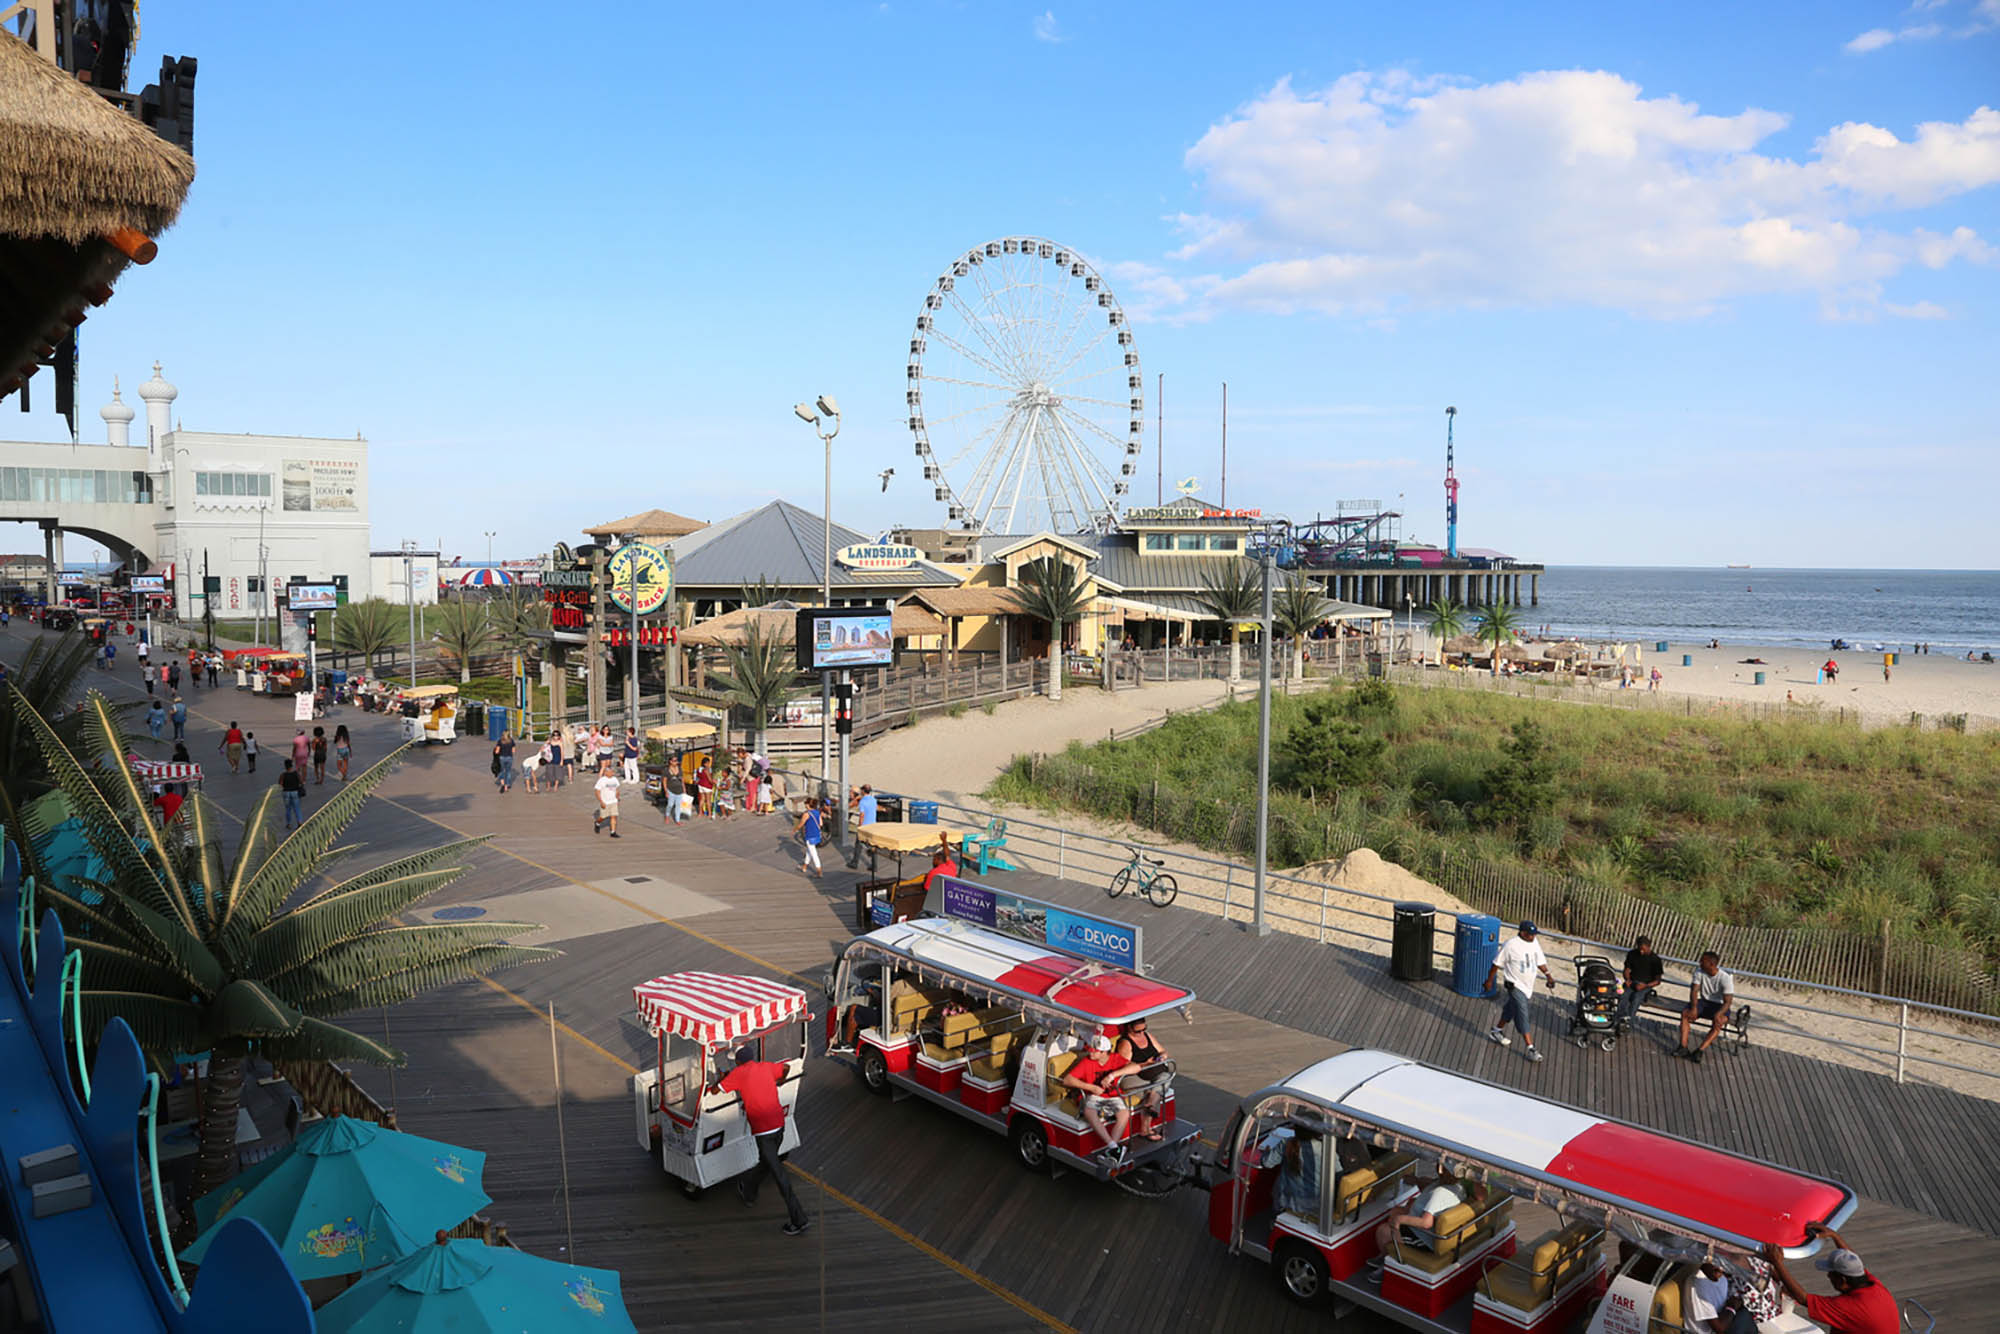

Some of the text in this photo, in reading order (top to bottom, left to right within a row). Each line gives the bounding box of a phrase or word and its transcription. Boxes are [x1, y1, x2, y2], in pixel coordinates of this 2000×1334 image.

[1127, 508, 1261, 518] LANDSHARK Bar & Grill
[847, 547, 917, 559] LANDSHARK
[637, 587, 665, 608] SHACK
[611, 626, 678, 647] REORTS
[947, 890, 991, 909] GATEWAY
[1067, 925, 1130, 952] ACDEVCO
[1612, 1294, 1635, 1310] FARE
